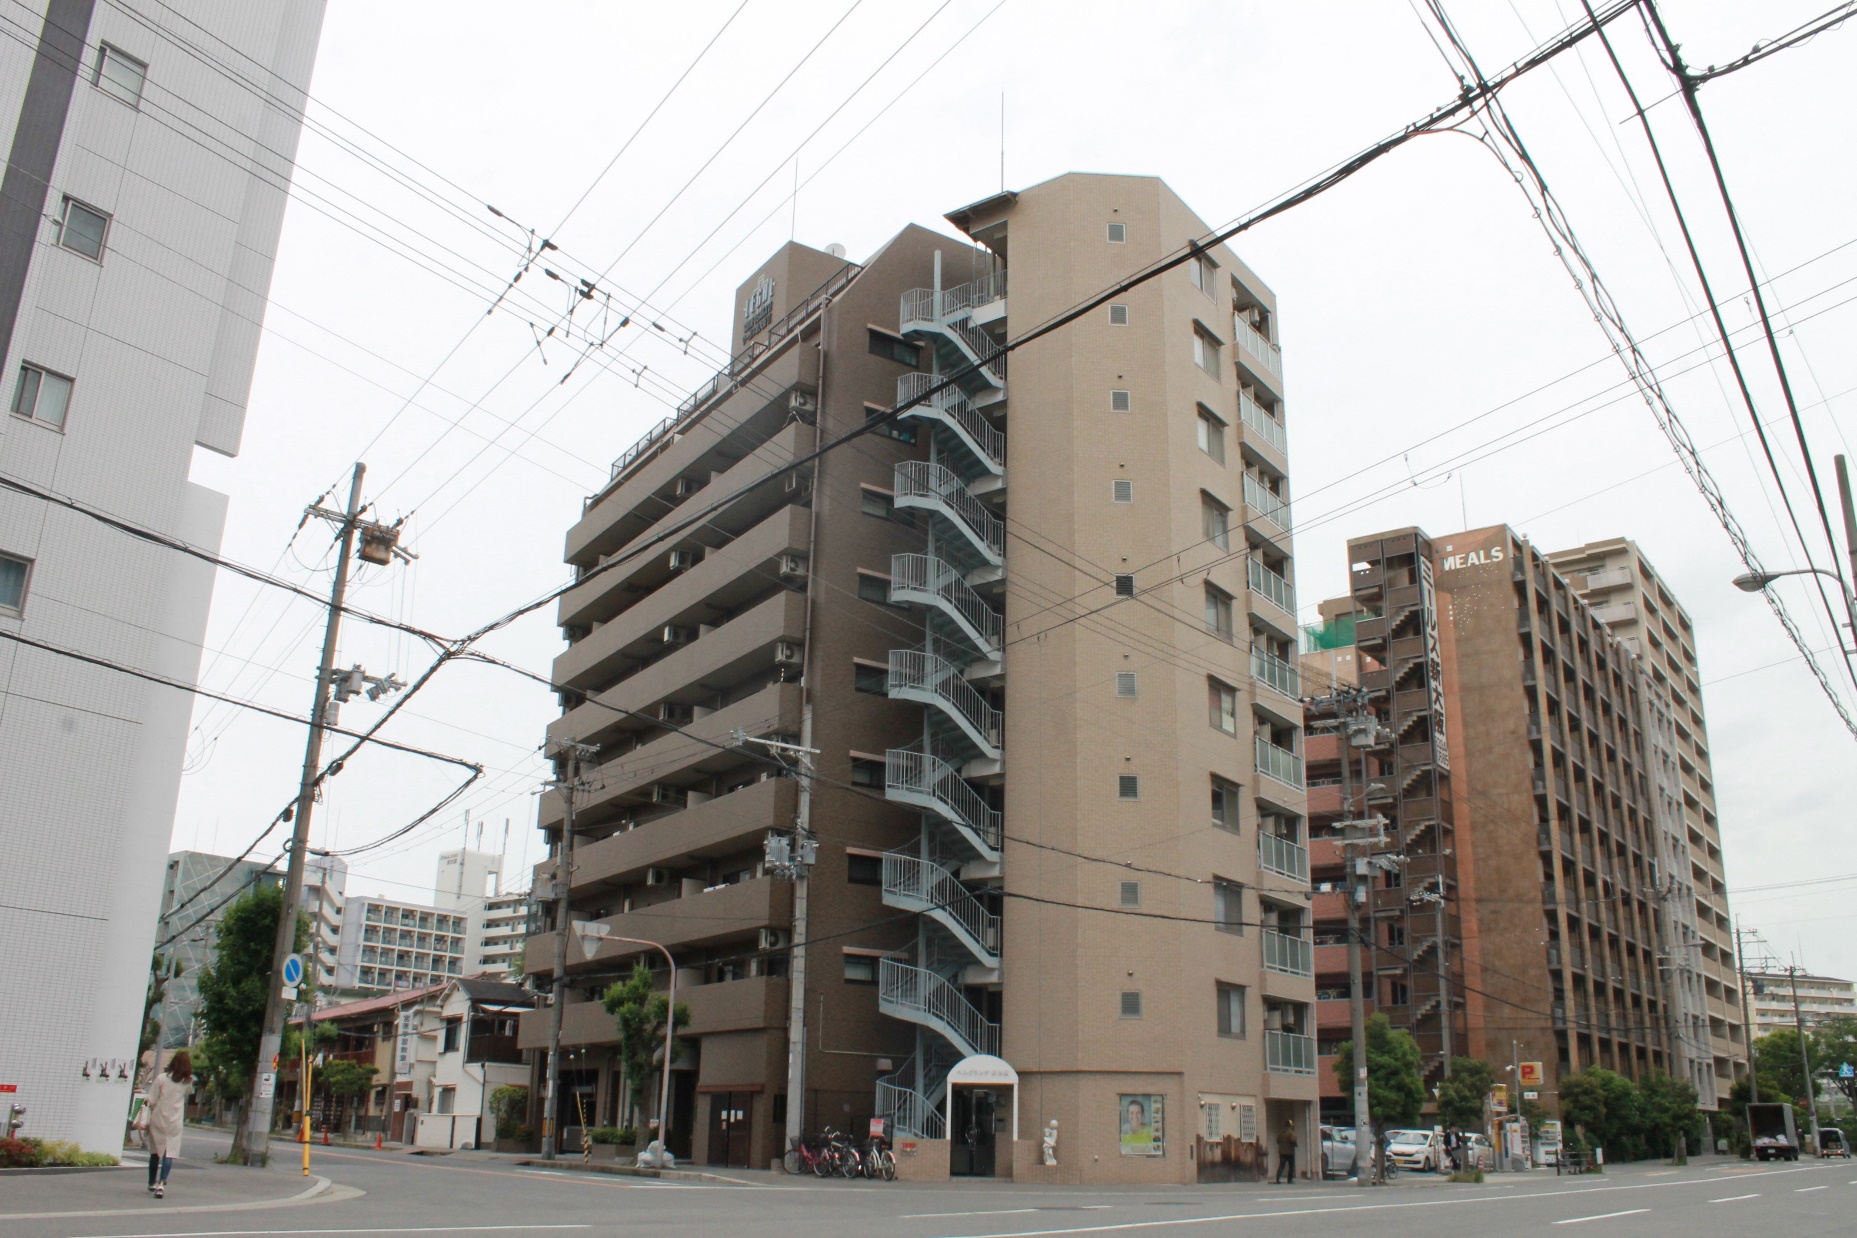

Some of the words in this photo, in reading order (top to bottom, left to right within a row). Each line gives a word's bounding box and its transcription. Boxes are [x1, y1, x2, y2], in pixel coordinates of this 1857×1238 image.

[1442, 545, 1504, 571] MEALS
[1420, 555, 1445, 737] ミールス新大阪
